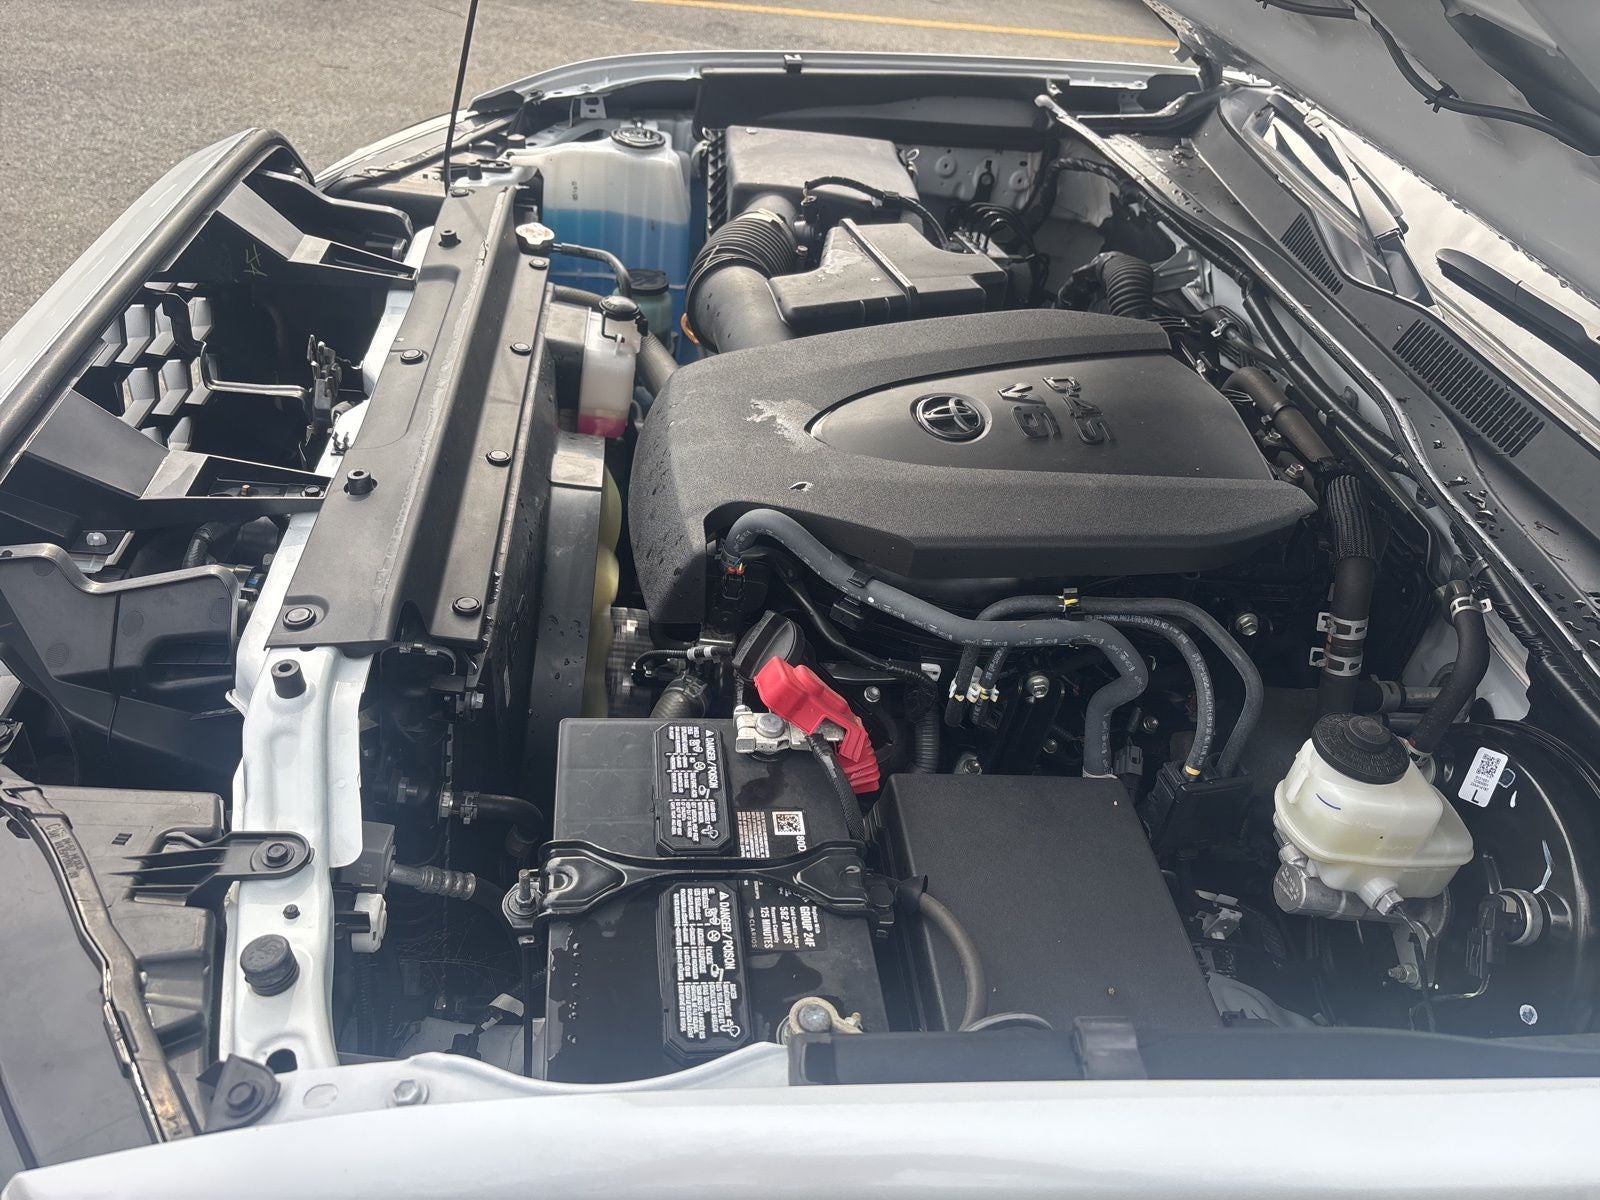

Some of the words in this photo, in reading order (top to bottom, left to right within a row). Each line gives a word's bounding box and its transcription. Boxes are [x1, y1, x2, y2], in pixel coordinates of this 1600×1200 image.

[997, 382, 1063, 441] V6
[759, 906, 769, 918] 125
[779, 906, 789, 920] 582
[799, 905, 812, 931] GROUP
[749, 918, 757, 949] CLARIOS
[761, 918, 774, 949] MINUTES
[780, 921, 793, 945] AMPS
[791, 916, 799, 935] Cranking
[803, 932, 816, 948] 24F
